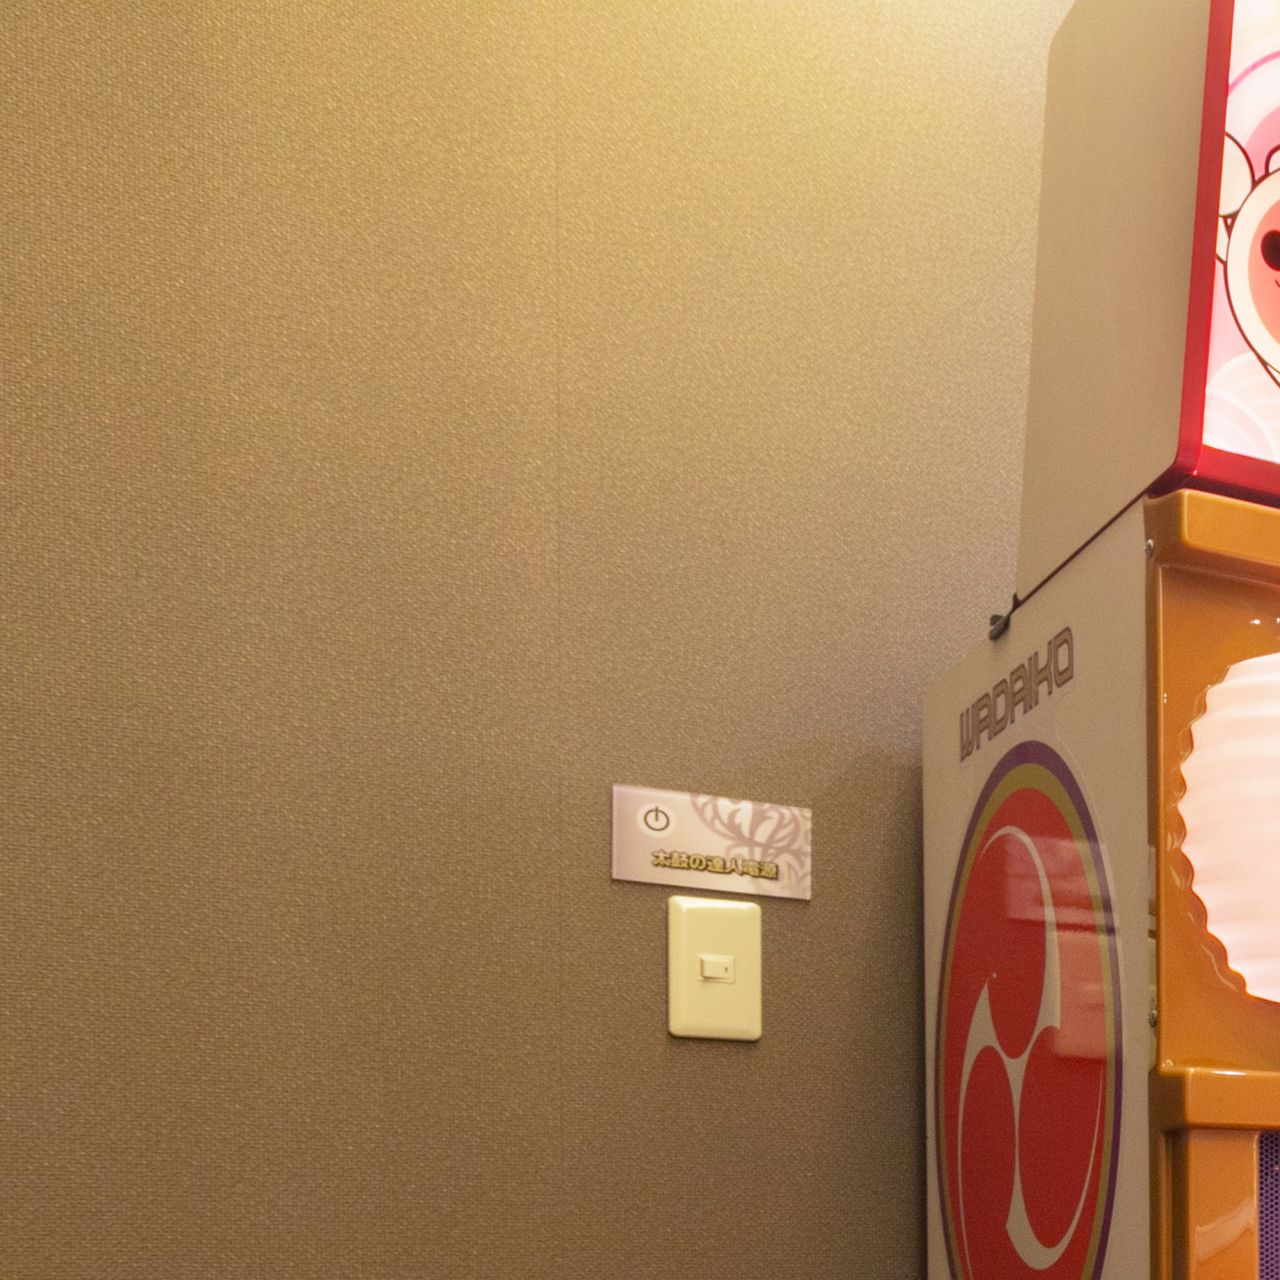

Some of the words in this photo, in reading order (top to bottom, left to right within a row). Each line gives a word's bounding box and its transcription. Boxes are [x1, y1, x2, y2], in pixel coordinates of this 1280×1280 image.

[652, 850, 779, 879] 太鼓の達人電源
